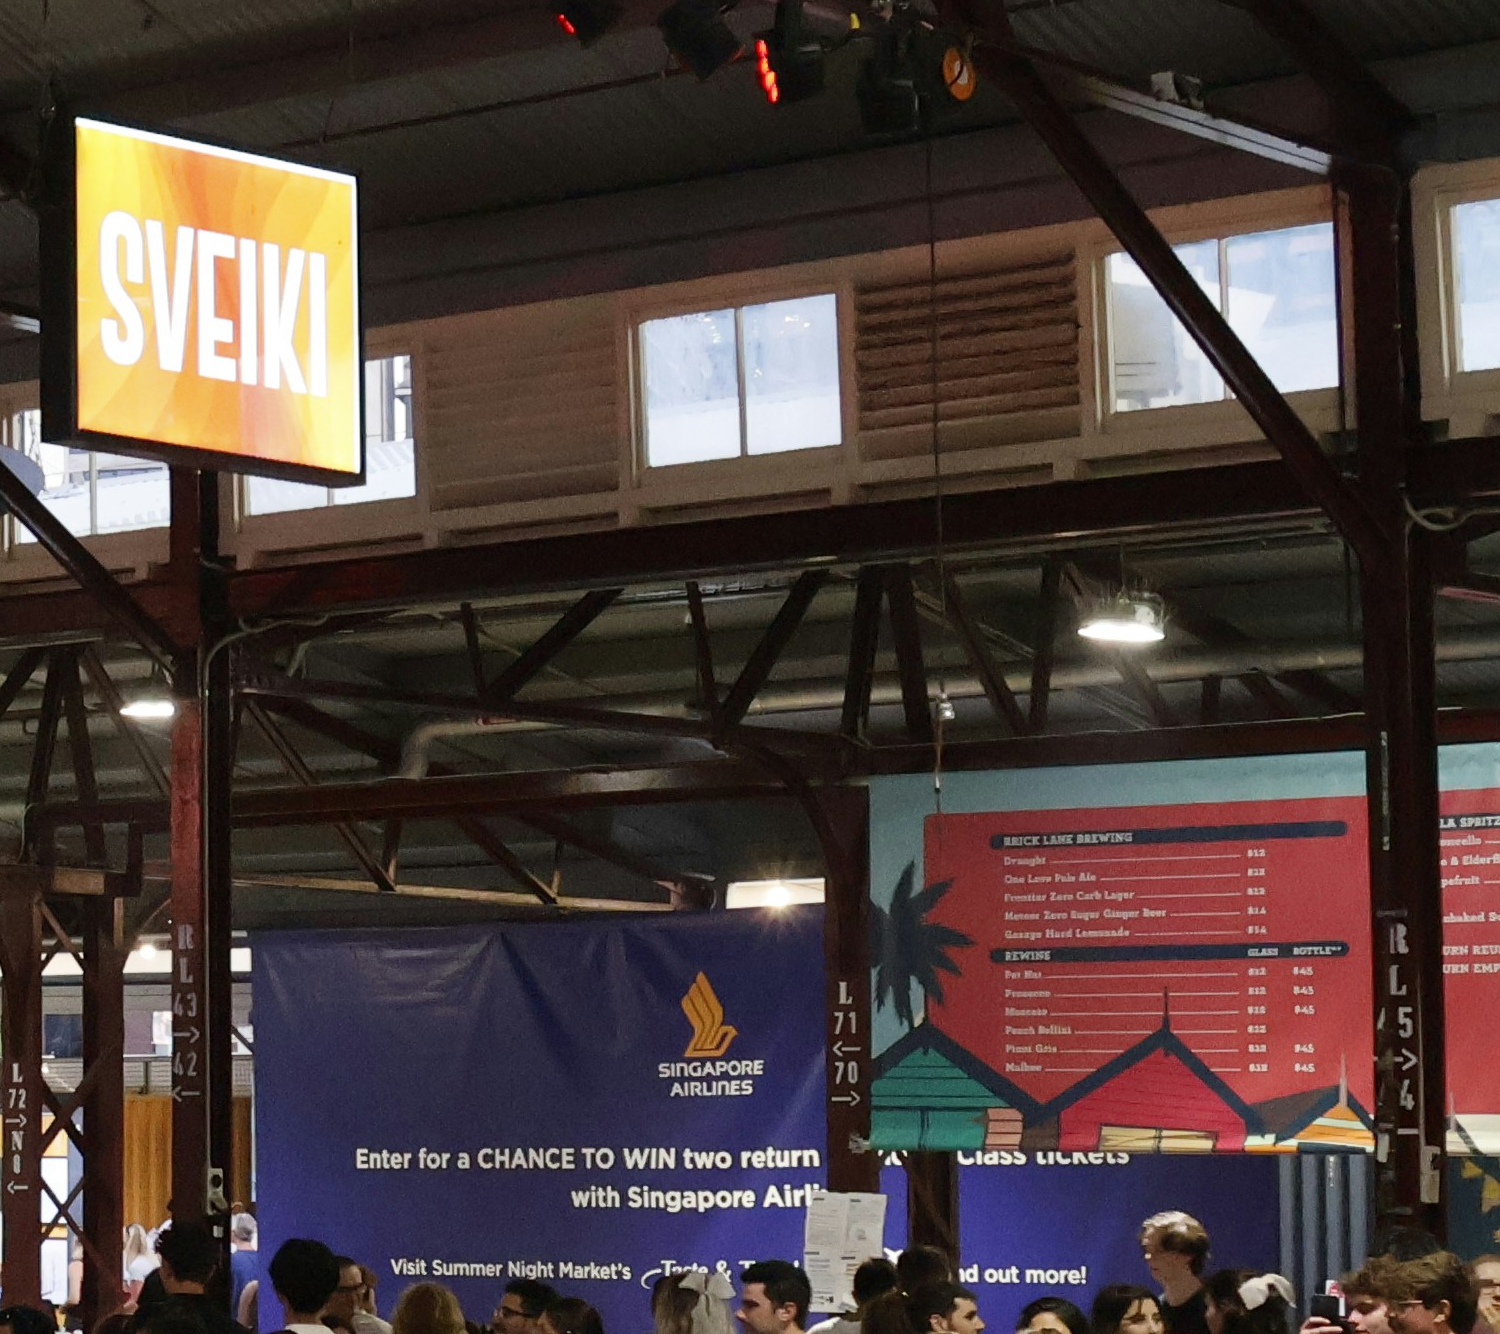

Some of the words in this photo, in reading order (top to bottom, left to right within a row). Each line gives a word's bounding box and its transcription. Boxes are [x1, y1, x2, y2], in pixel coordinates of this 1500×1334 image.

[99, 209, 327, 398] SVEIKI
[1076, 832, 1133, 845] BREWING
[177, 924, 194, 950] R
[1389, 923, 1409, 955] R
[180, 957, 193, 984] L
[1389, 965, 1407, 996] L
[173, 992, 198, 1017] 43
[839, 981, 853, 1005] L
[833, 1011, 857, 1035] 71
[1397, 1006, 1414, 1039] 5
[12, 1062, 23, 1083] L
[173, 1052, 197, 1076] 42
[658, 1060, 764, 1079] SINGAPORE
[834, 1061, 859, 1085] 70
[8, 1088, 27, 1109] 72
[670, 1079, 754, 1097] AIRLINES
[1399, 1079, 1415, 1111] 4
[11, 1130, 23, 1151] N
[355, 1149, 416, 1170] Enter
[418, 1148, 454, 1170] for
[457, 1153, 471, 1170] a
[476, 1148, 576, 1170] CHANCE
[581, 1148, 615, 1170] TO
[622, 1148, 677, 1170] WIN
[683, 1149, 733, 1170] two
[740, 1148, 821, 1169] return
[571, 1186, 621, 1209] with
[627, 1186, 756, 1212] Singapore
[762, 1184, 822, 1209] Airl
[390, 1259, 428, 1277] Visit
[431, 1260, 503, 1278] Summer
[507, 1261, 555, 1281] Night
[558, 1261, 632, 1281] Market's
[984, 1266, 1021, 1284] out
[1025, 1266, 1088, 1285] more!
